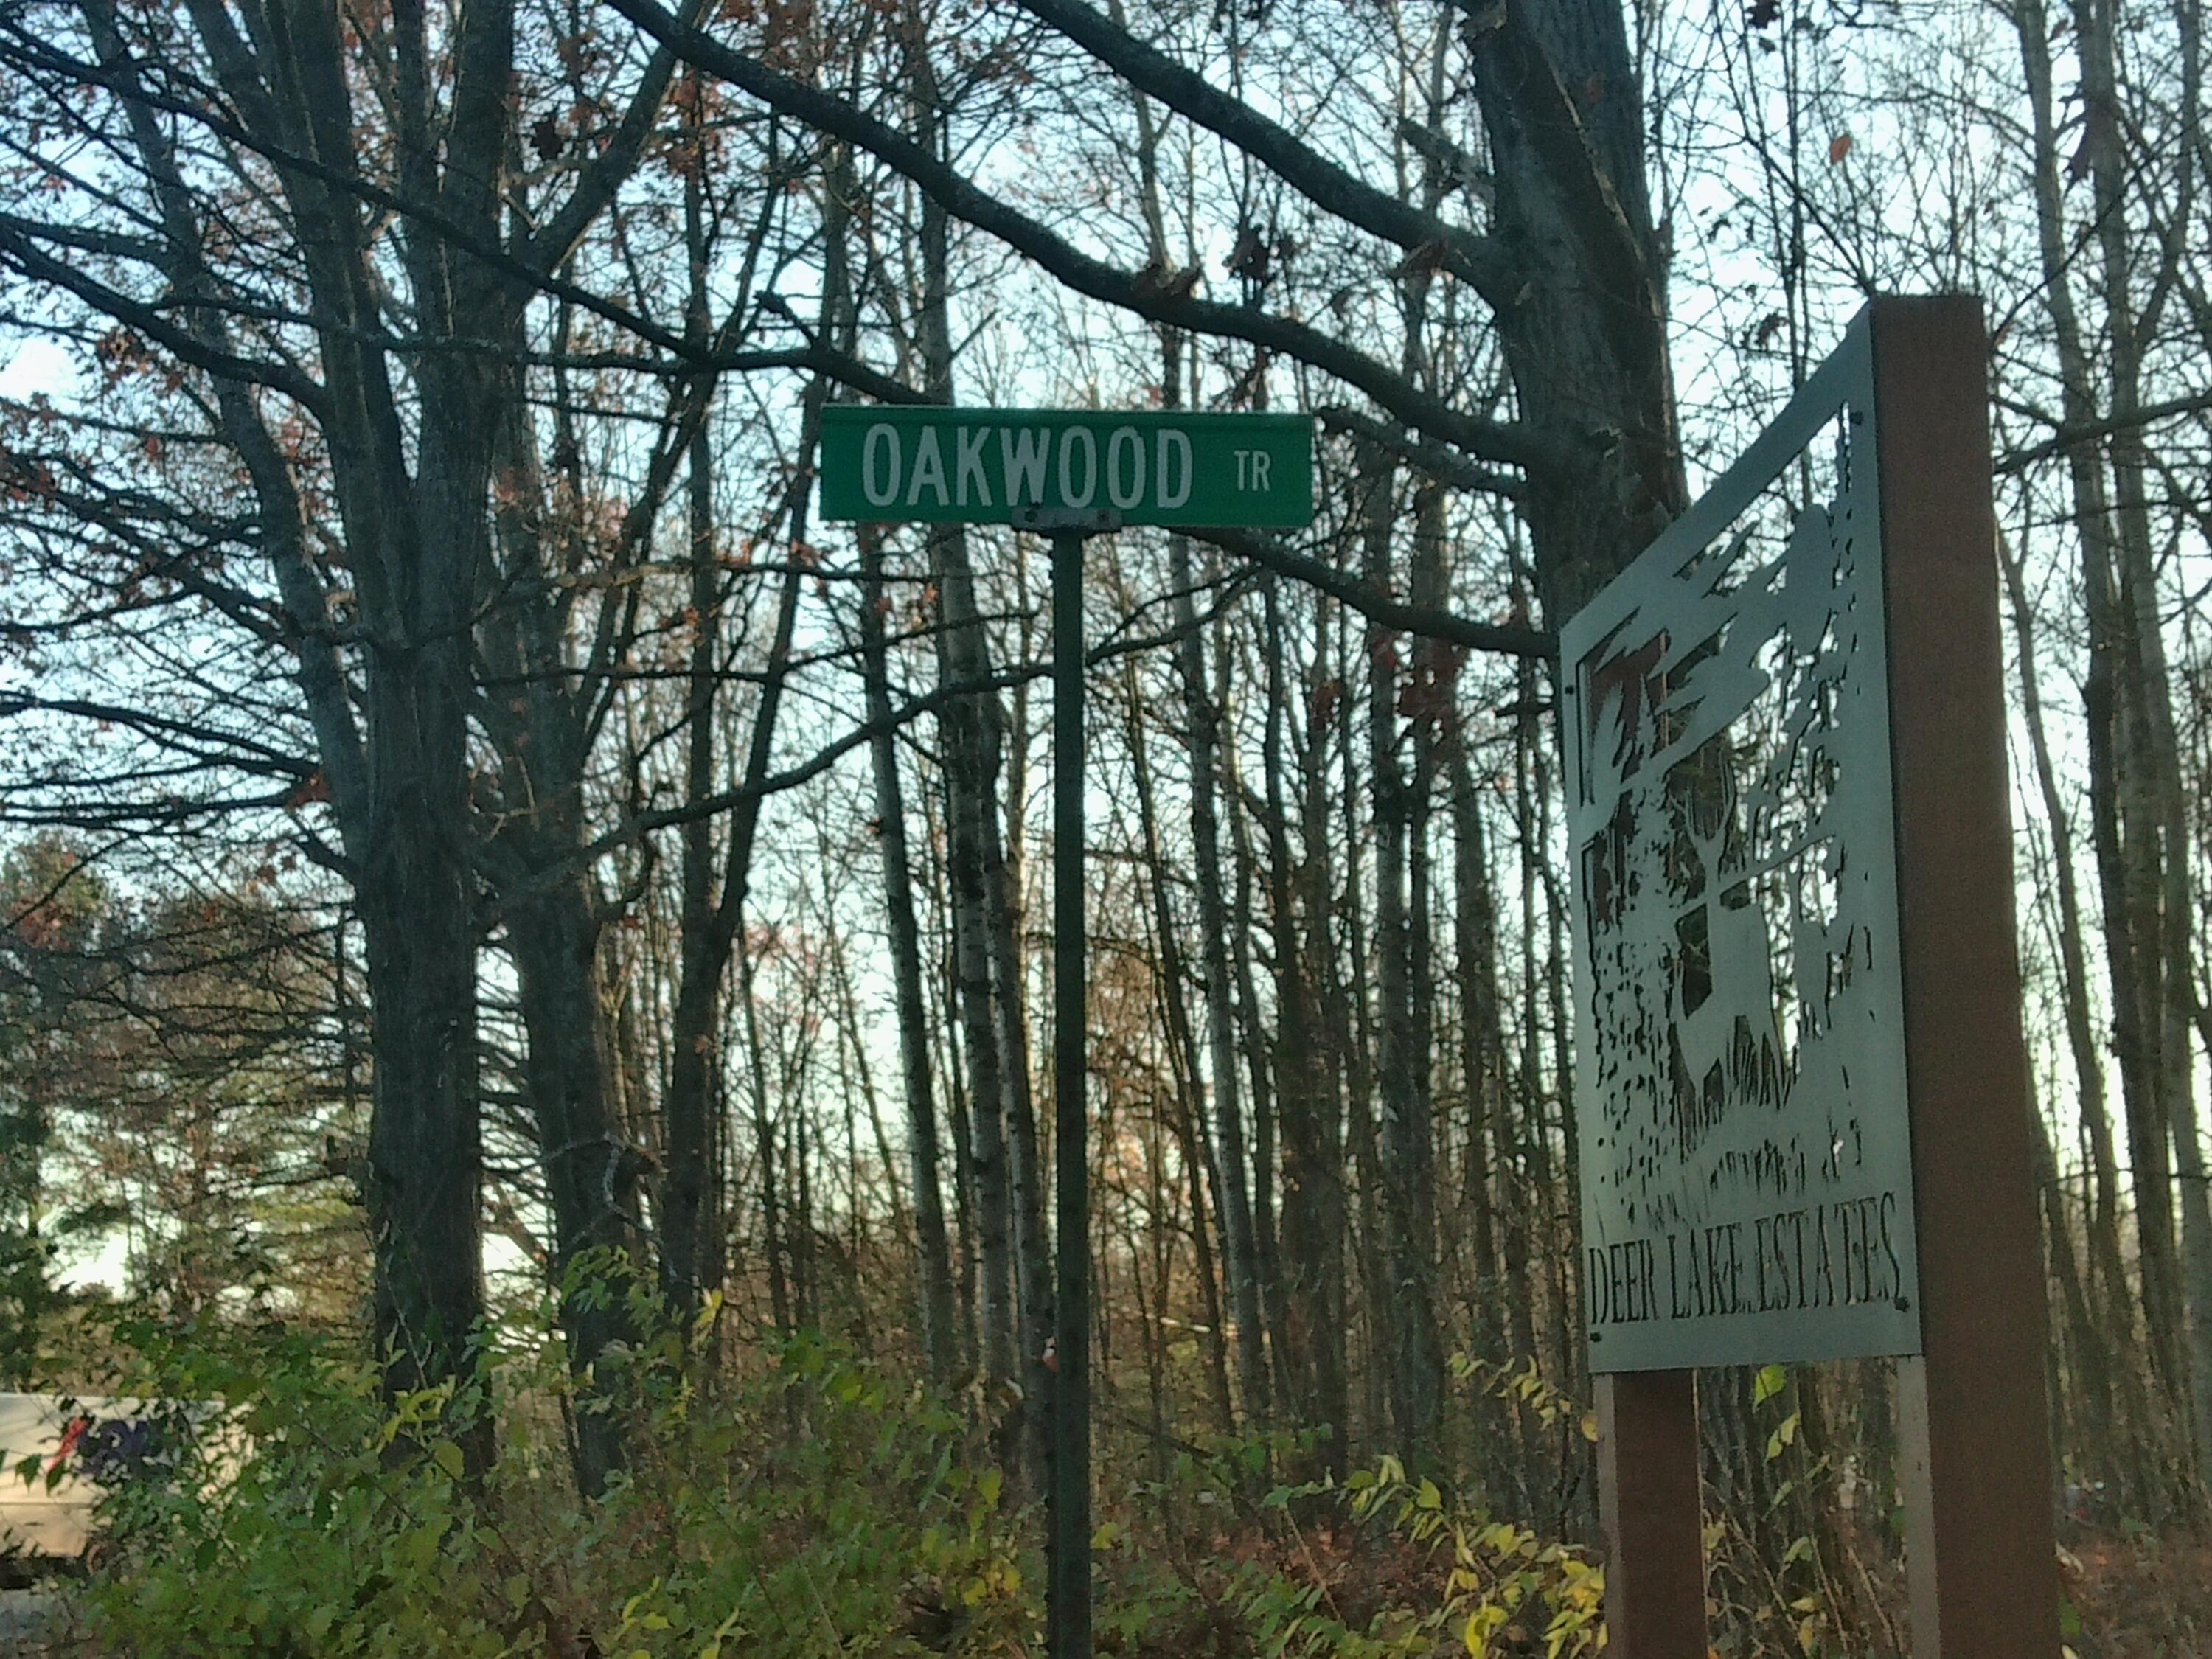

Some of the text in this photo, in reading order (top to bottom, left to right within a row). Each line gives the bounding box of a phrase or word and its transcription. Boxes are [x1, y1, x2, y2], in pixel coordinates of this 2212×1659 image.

[862, 422, 1271, 509] OAKWOOD TR
[1588, 1190, 1902, 1325] DEER LAKE ESTATES
